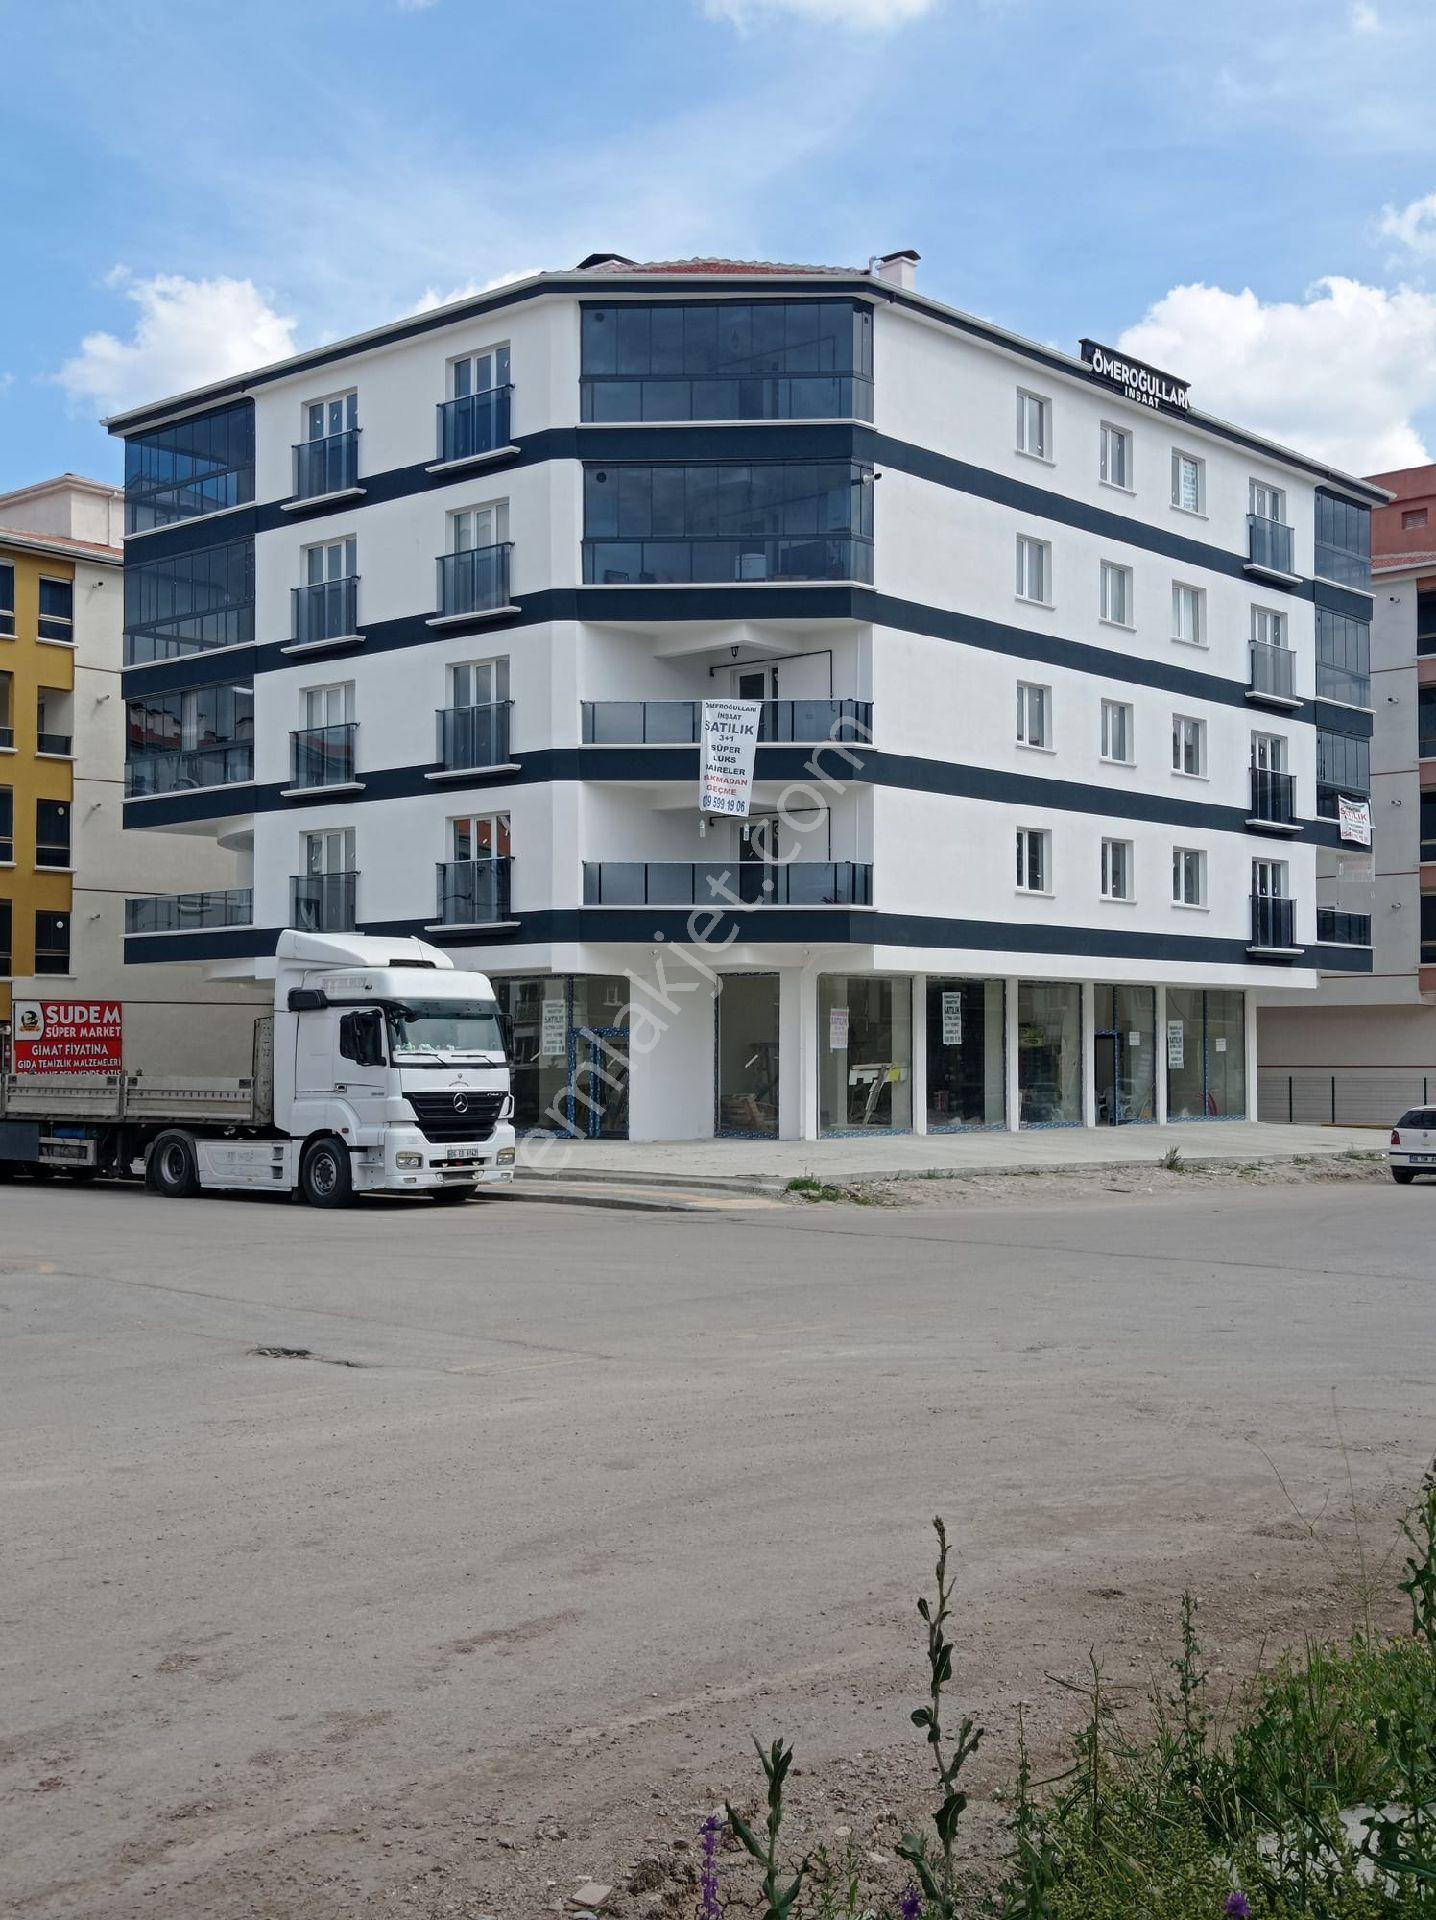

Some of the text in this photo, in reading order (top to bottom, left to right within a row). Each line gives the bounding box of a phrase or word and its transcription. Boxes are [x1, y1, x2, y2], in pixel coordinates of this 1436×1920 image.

[705, 720, 754, 735] SATILIK
[719, 734, 734, 742] 3+1
[711, 744, 741, 754] SÜPER
[46, 1005, 121, 1024] SUDEM
[46, 1025, 76, 1037] SÜPER
[80, 1026, 121, 1037] MARKET
